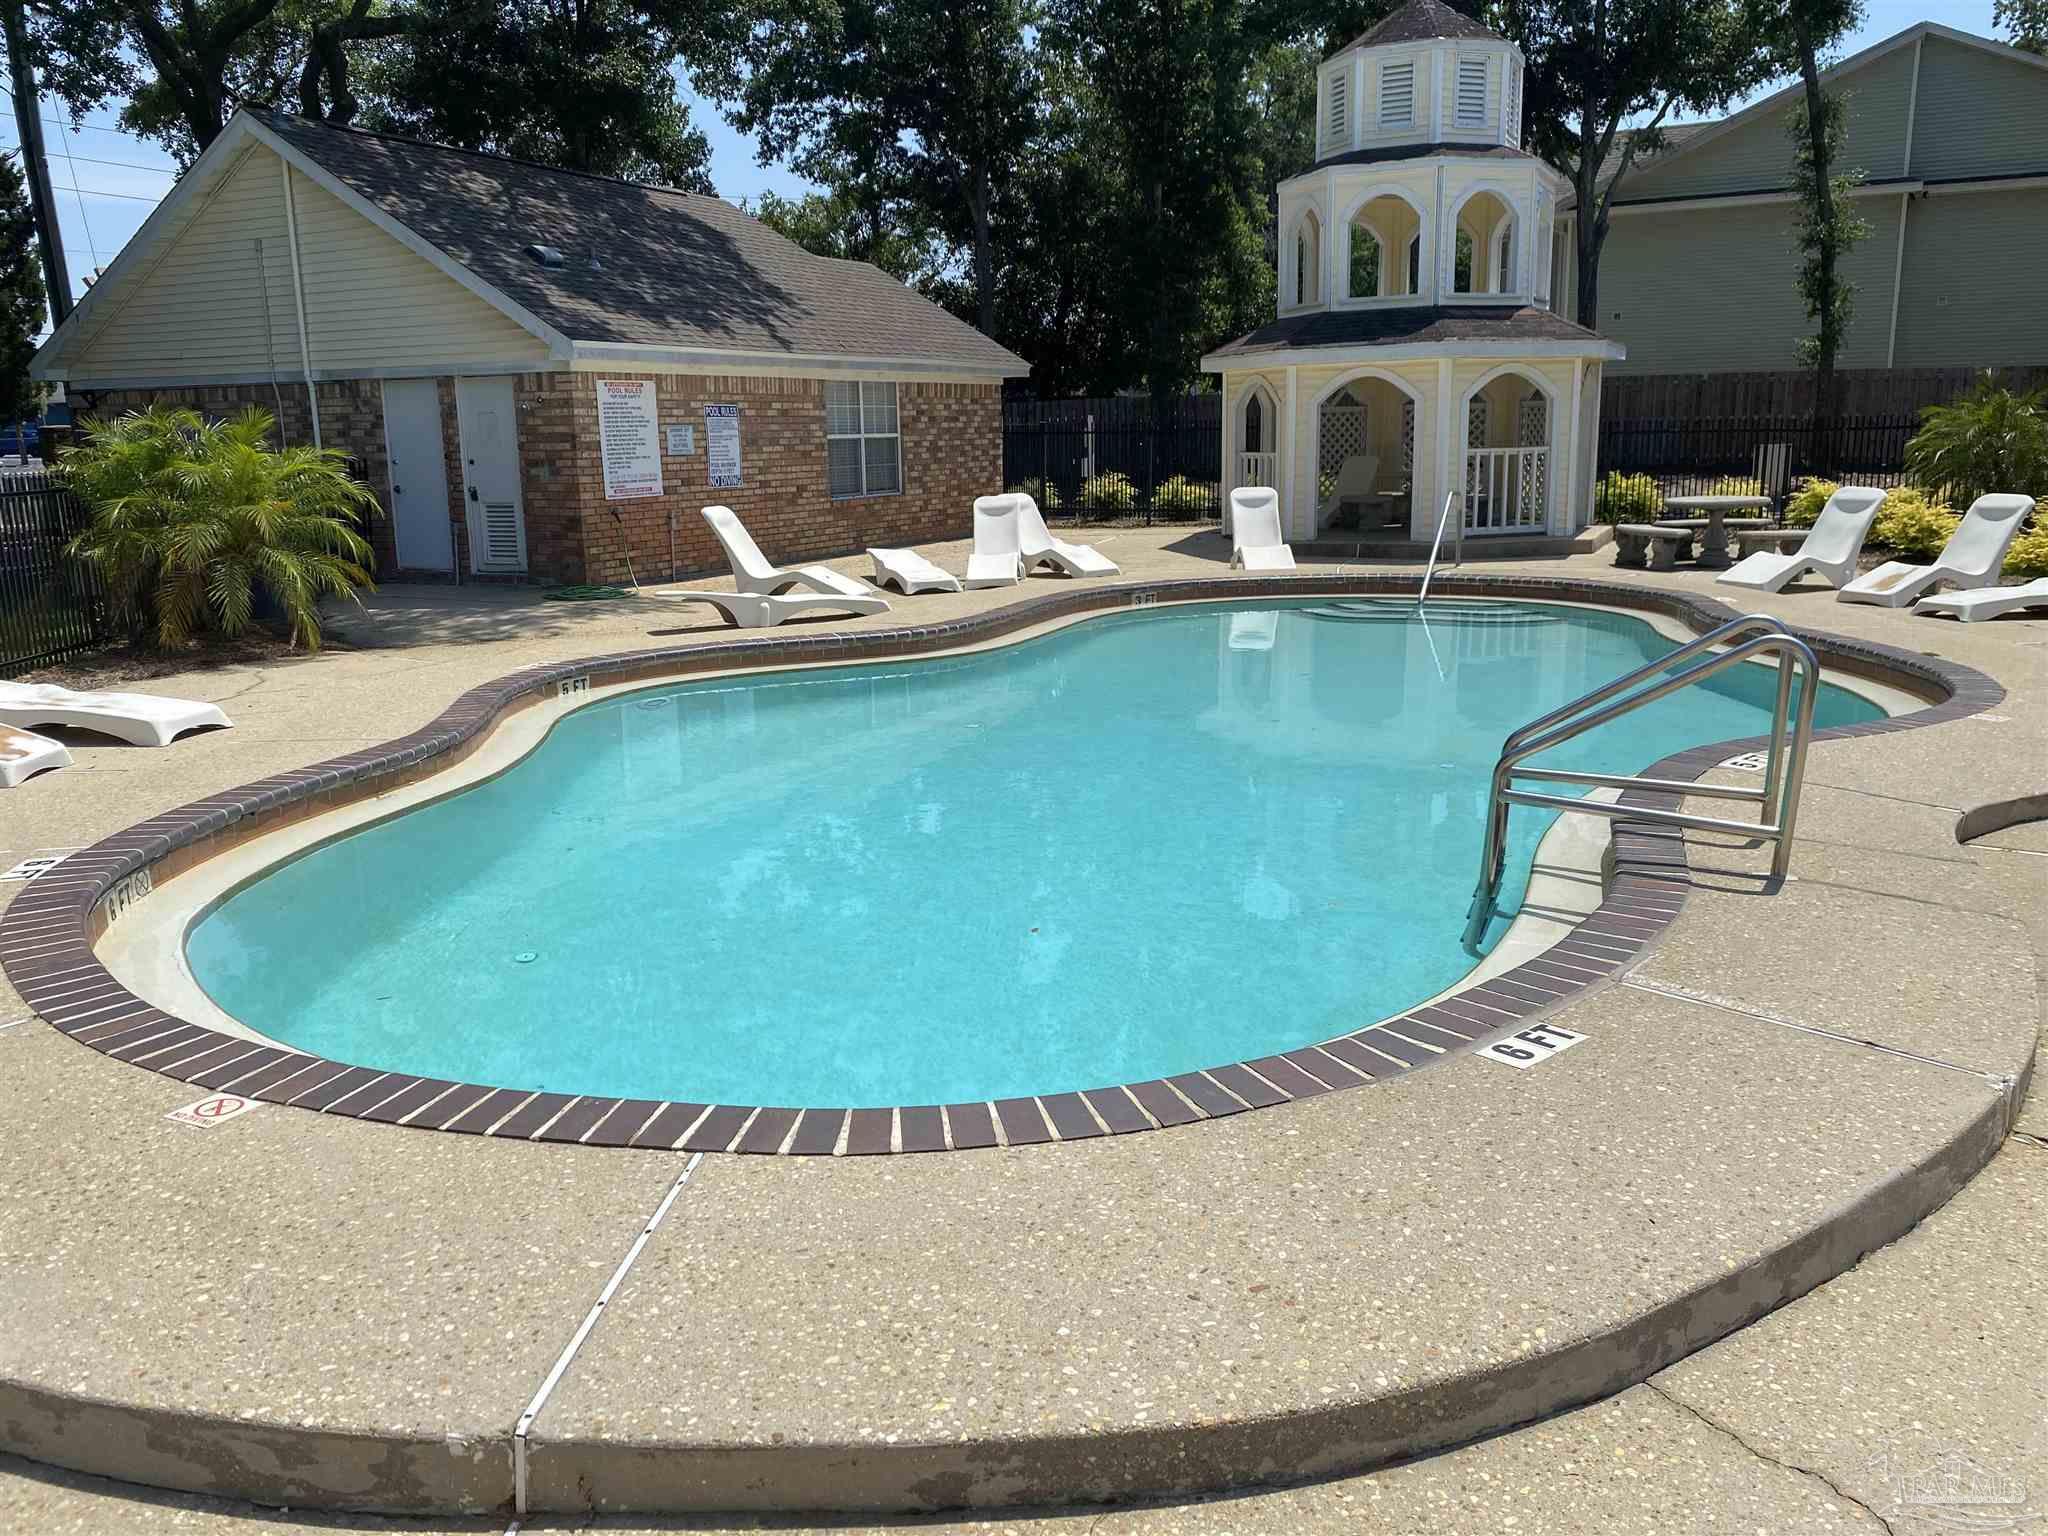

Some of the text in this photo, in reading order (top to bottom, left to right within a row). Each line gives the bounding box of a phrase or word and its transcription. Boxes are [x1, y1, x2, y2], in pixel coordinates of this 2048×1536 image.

[705, 406, 737, 416] POOL RULES
[710, 475, 742, 487] NO DIVING
[561, 678, 588, 695] 5 FT
[118, 882, 131, 912] FT
[1491, 1024, 1576, 1060] 6 FT
